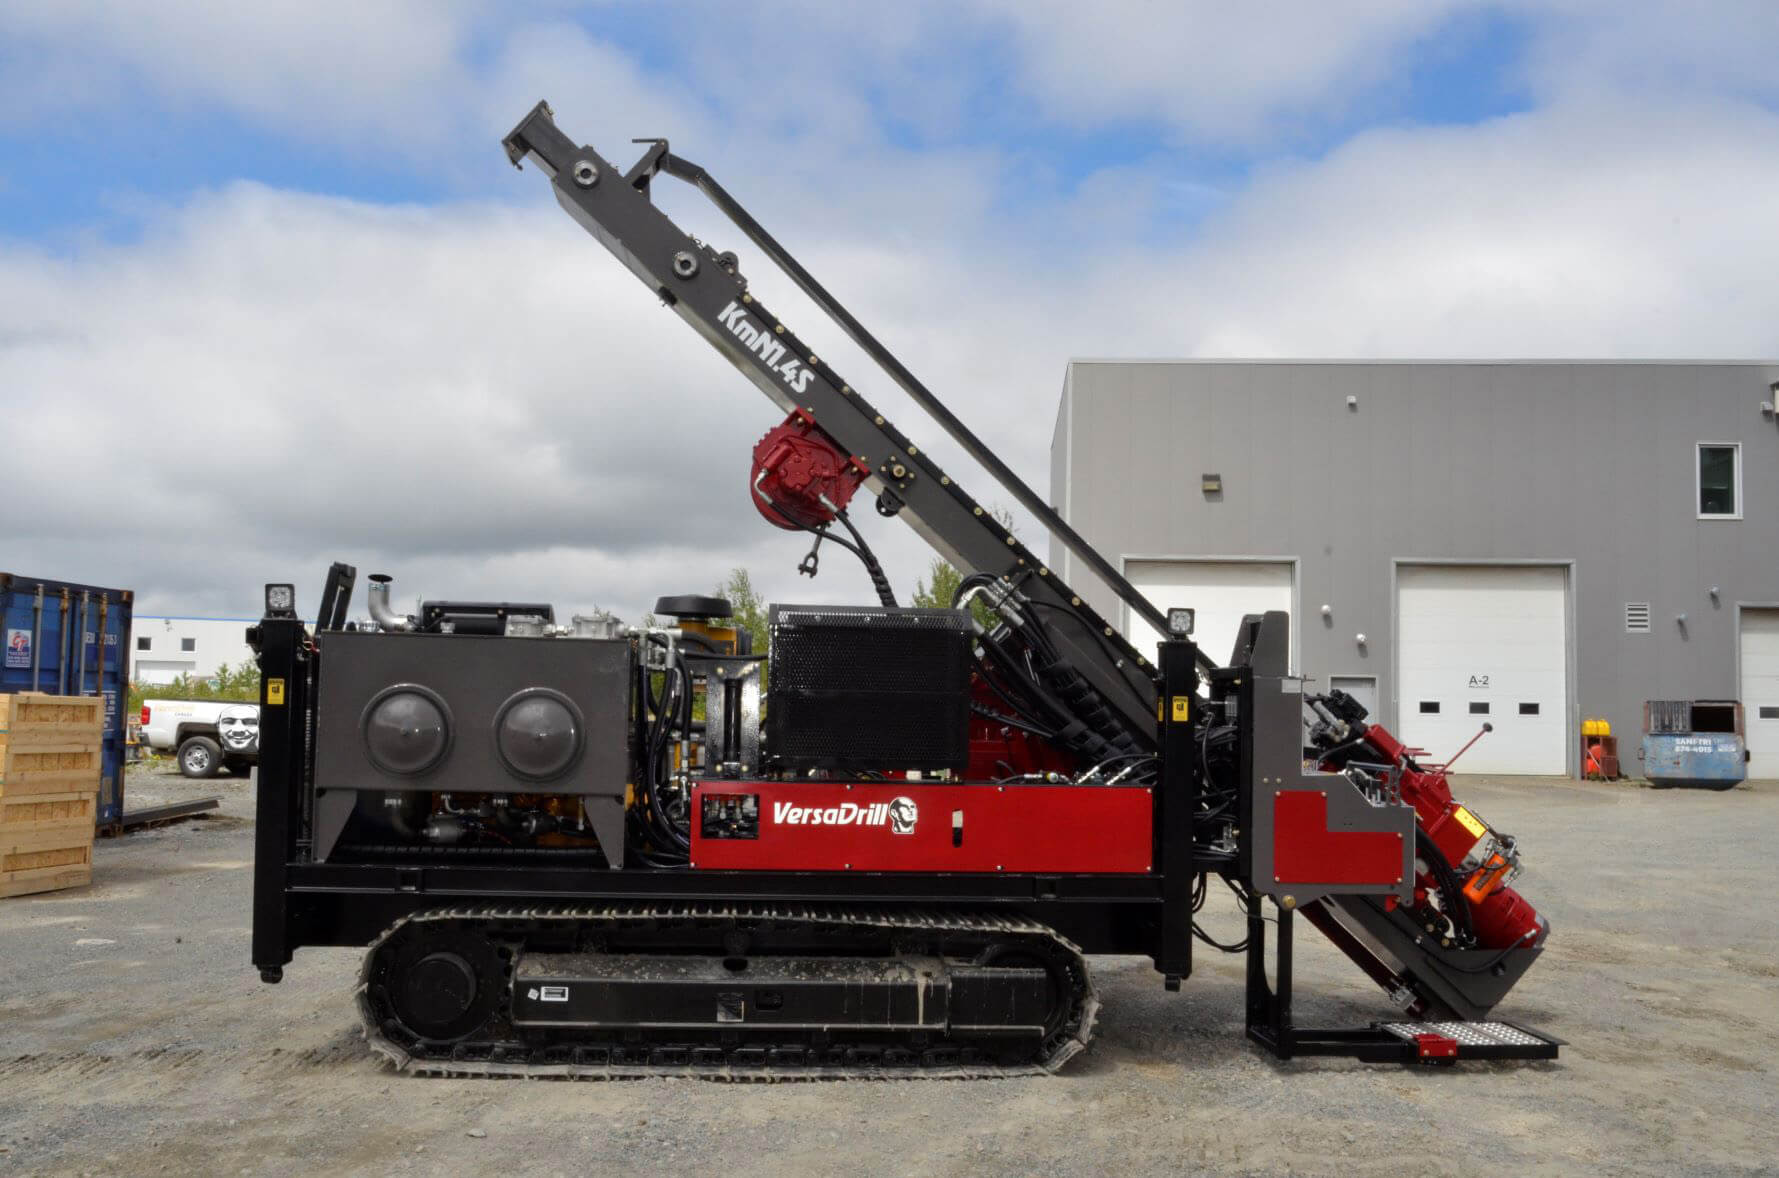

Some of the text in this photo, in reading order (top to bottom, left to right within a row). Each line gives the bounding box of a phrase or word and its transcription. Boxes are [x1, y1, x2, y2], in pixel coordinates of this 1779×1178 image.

[717, 300, 816, 393] KmN1.4S
[1469, 675, 1489, 685] A-2
[773, 801, 889, 826] VersaDrill
